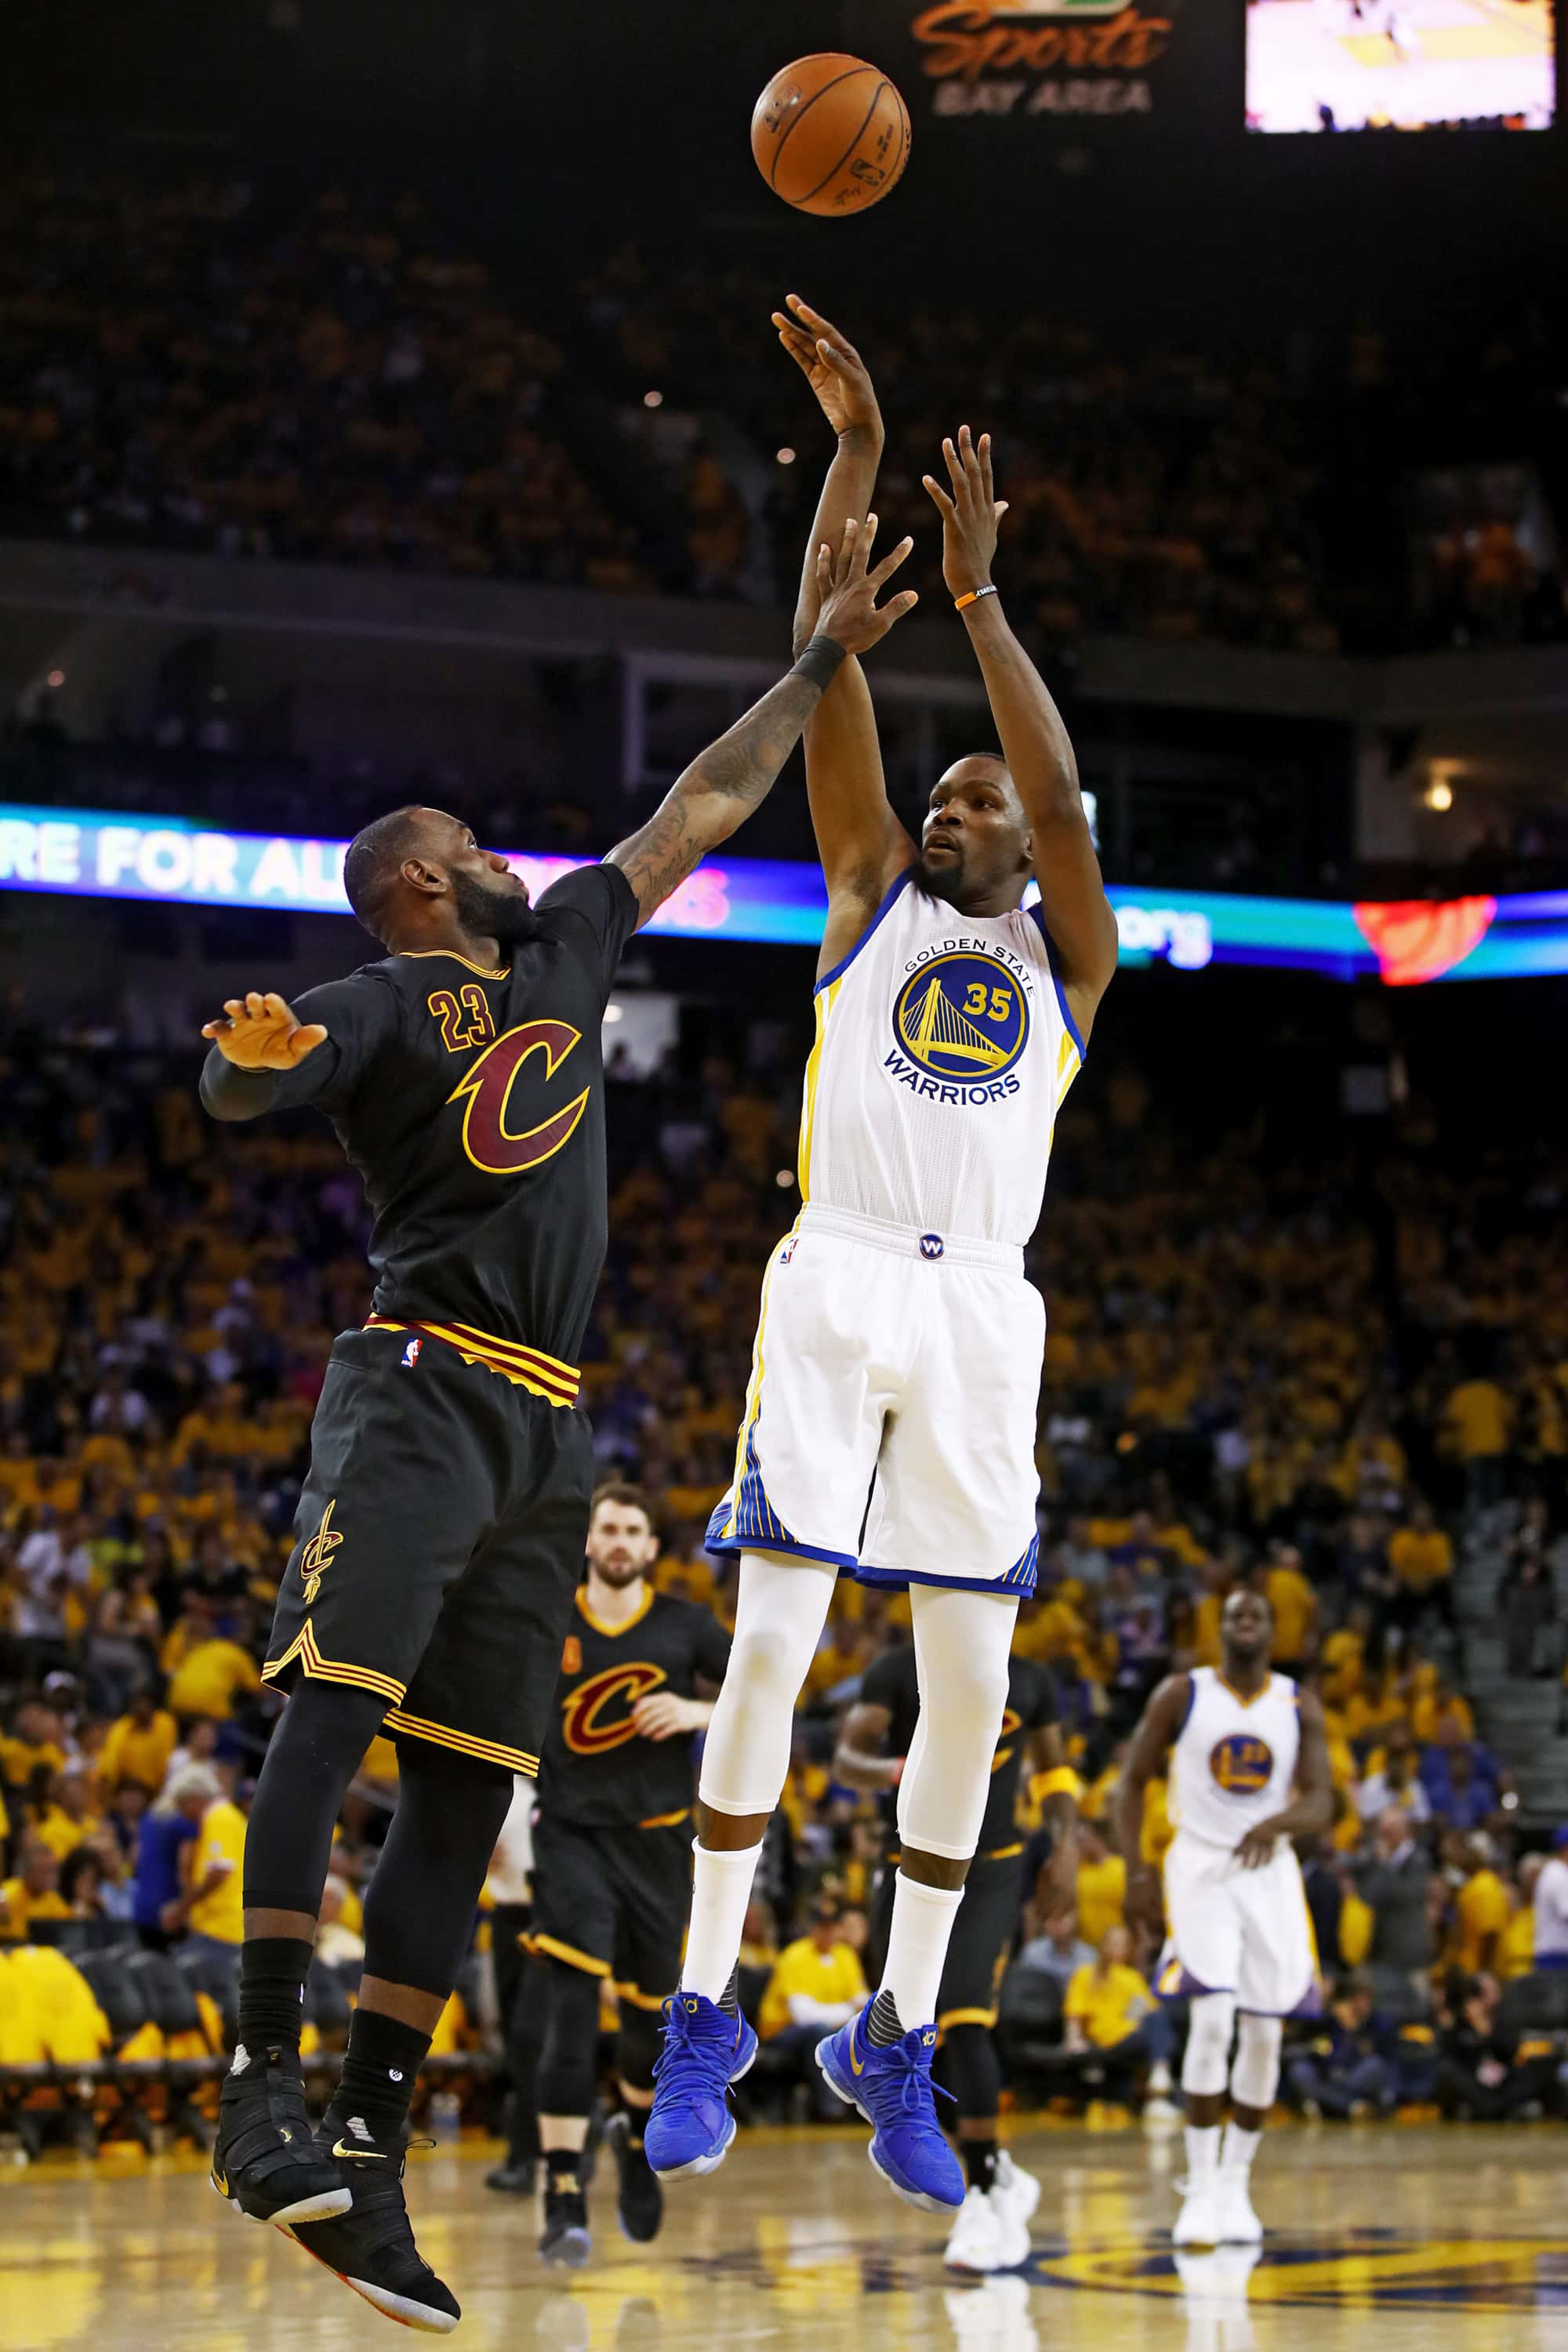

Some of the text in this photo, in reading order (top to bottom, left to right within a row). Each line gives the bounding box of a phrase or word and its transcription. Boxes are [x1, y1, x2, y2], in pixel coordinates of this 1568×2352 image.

[911, 0, 1173, 78] Sports
[932, 79, 1153, 115] BAY AREA
[96, 826, 238, 893] FOR
[904, 938, 1036, 999] GOLDEN STATE
[427, 983, 496, 1054] 23
[963, 982, 1012, 1022] 35
[445, 1018, 591, 1174] C
[883, 1048, 1021, 1106] WARRIORS
[921, 1239, 942, 1255] W
[561, 1661, 668, 1755] C
